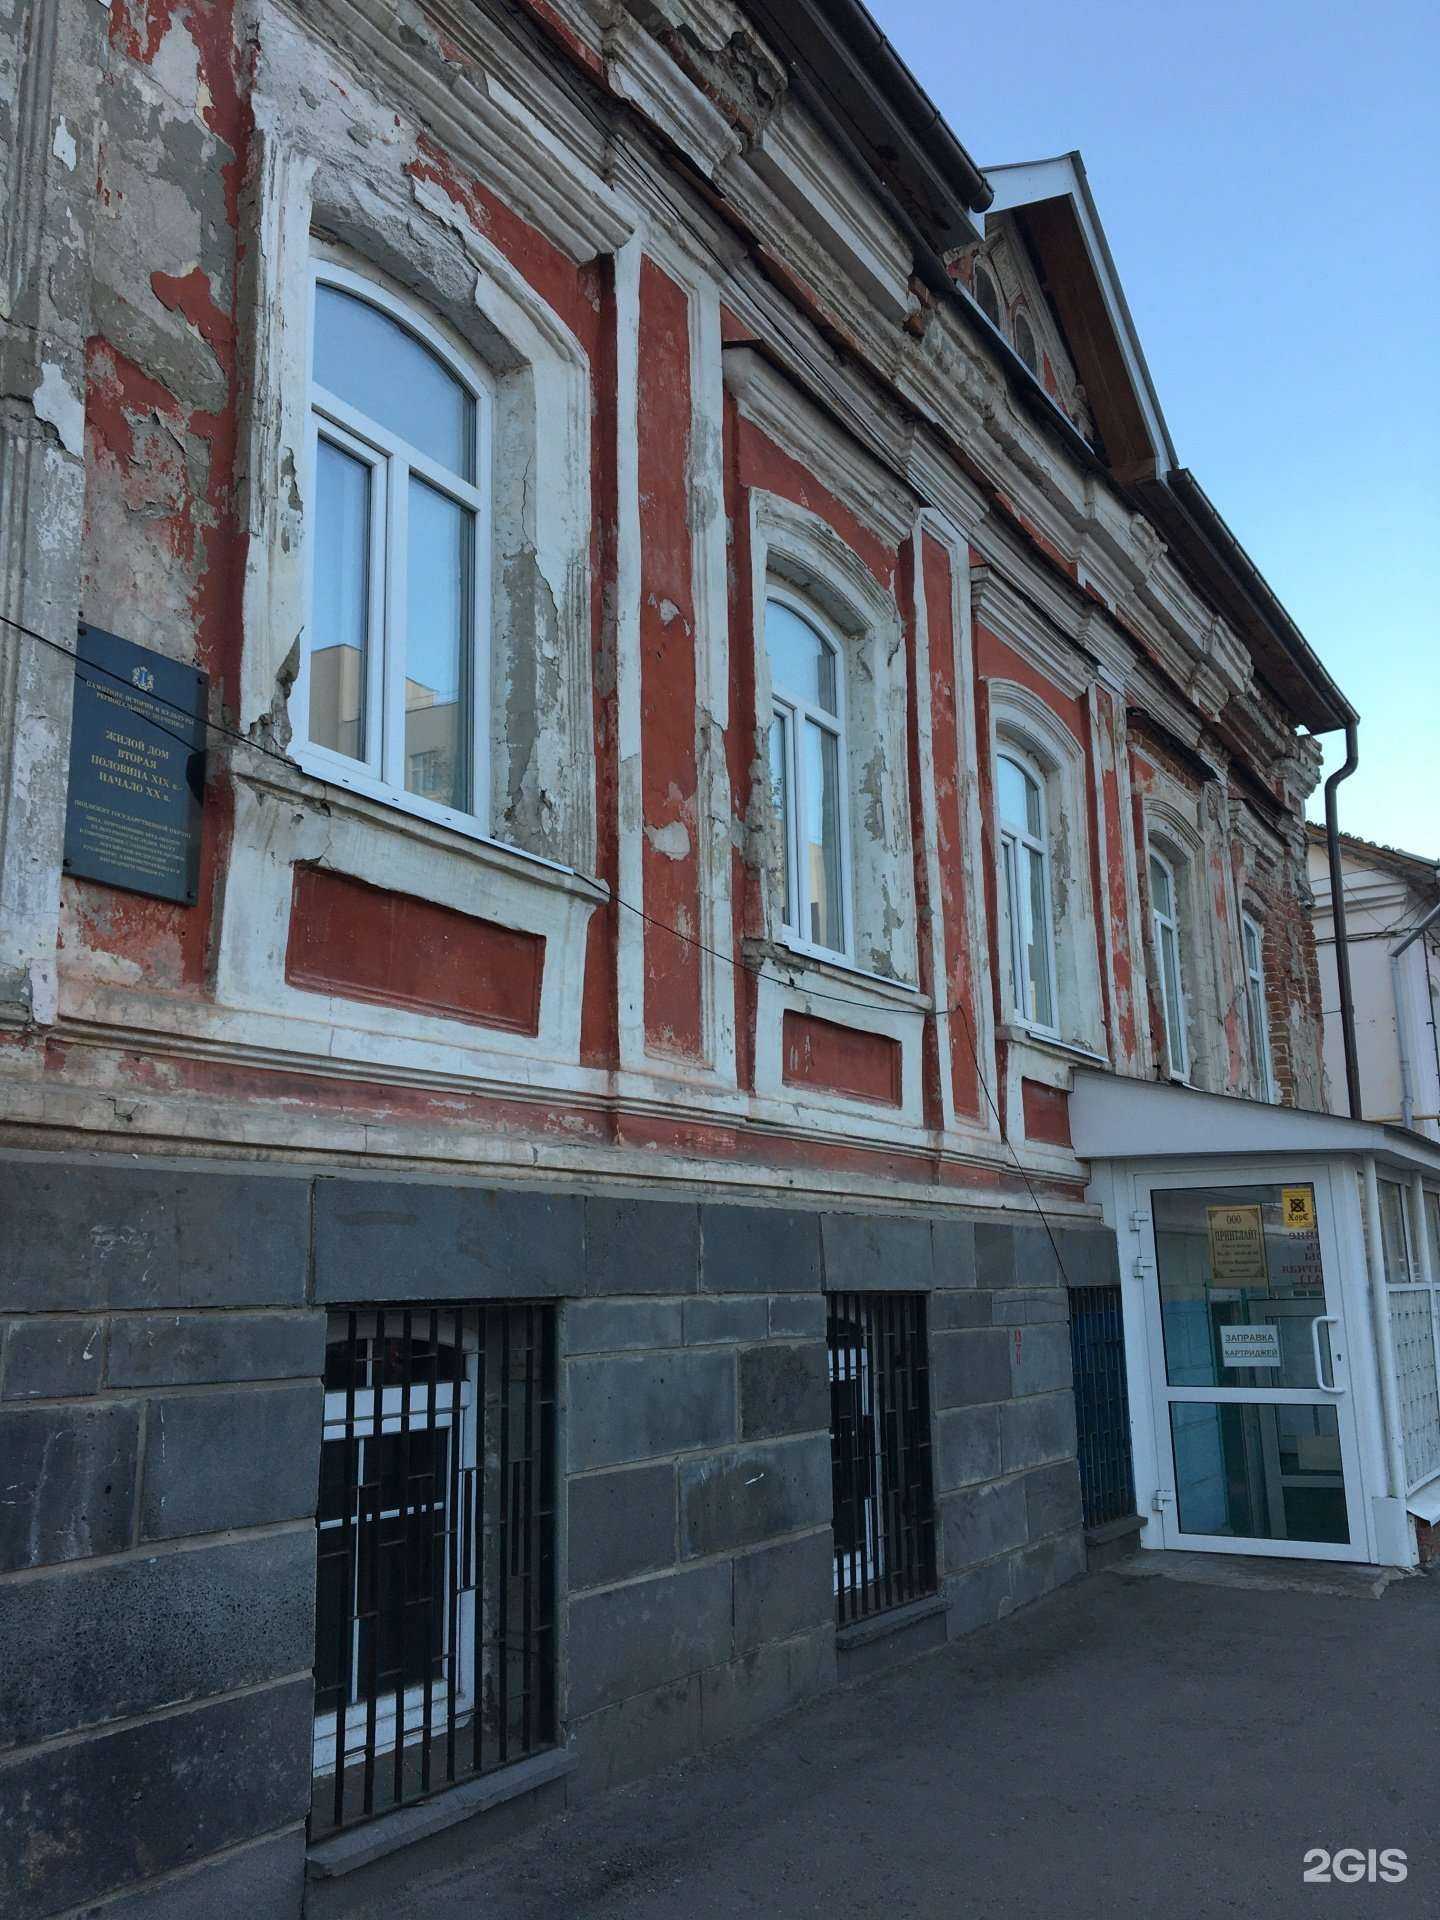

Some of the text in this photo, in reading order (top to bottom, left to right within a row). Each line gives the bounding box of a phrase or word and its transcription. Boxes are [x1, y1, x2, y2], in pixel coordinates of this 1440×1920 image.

[105, 731, 169, 760] ЖИЛОЙ ДОМ
[91, 754, 148, 781] ПОЛОВИНА
[118, 749, 157, 769] ВТОРАЯ
[99, 771, 143, 793] НАЧАЛО
[1226, 1215, 1241, 1225] ООО
[1225, 1333, 1274, 1342] ЗАПРАВКА
